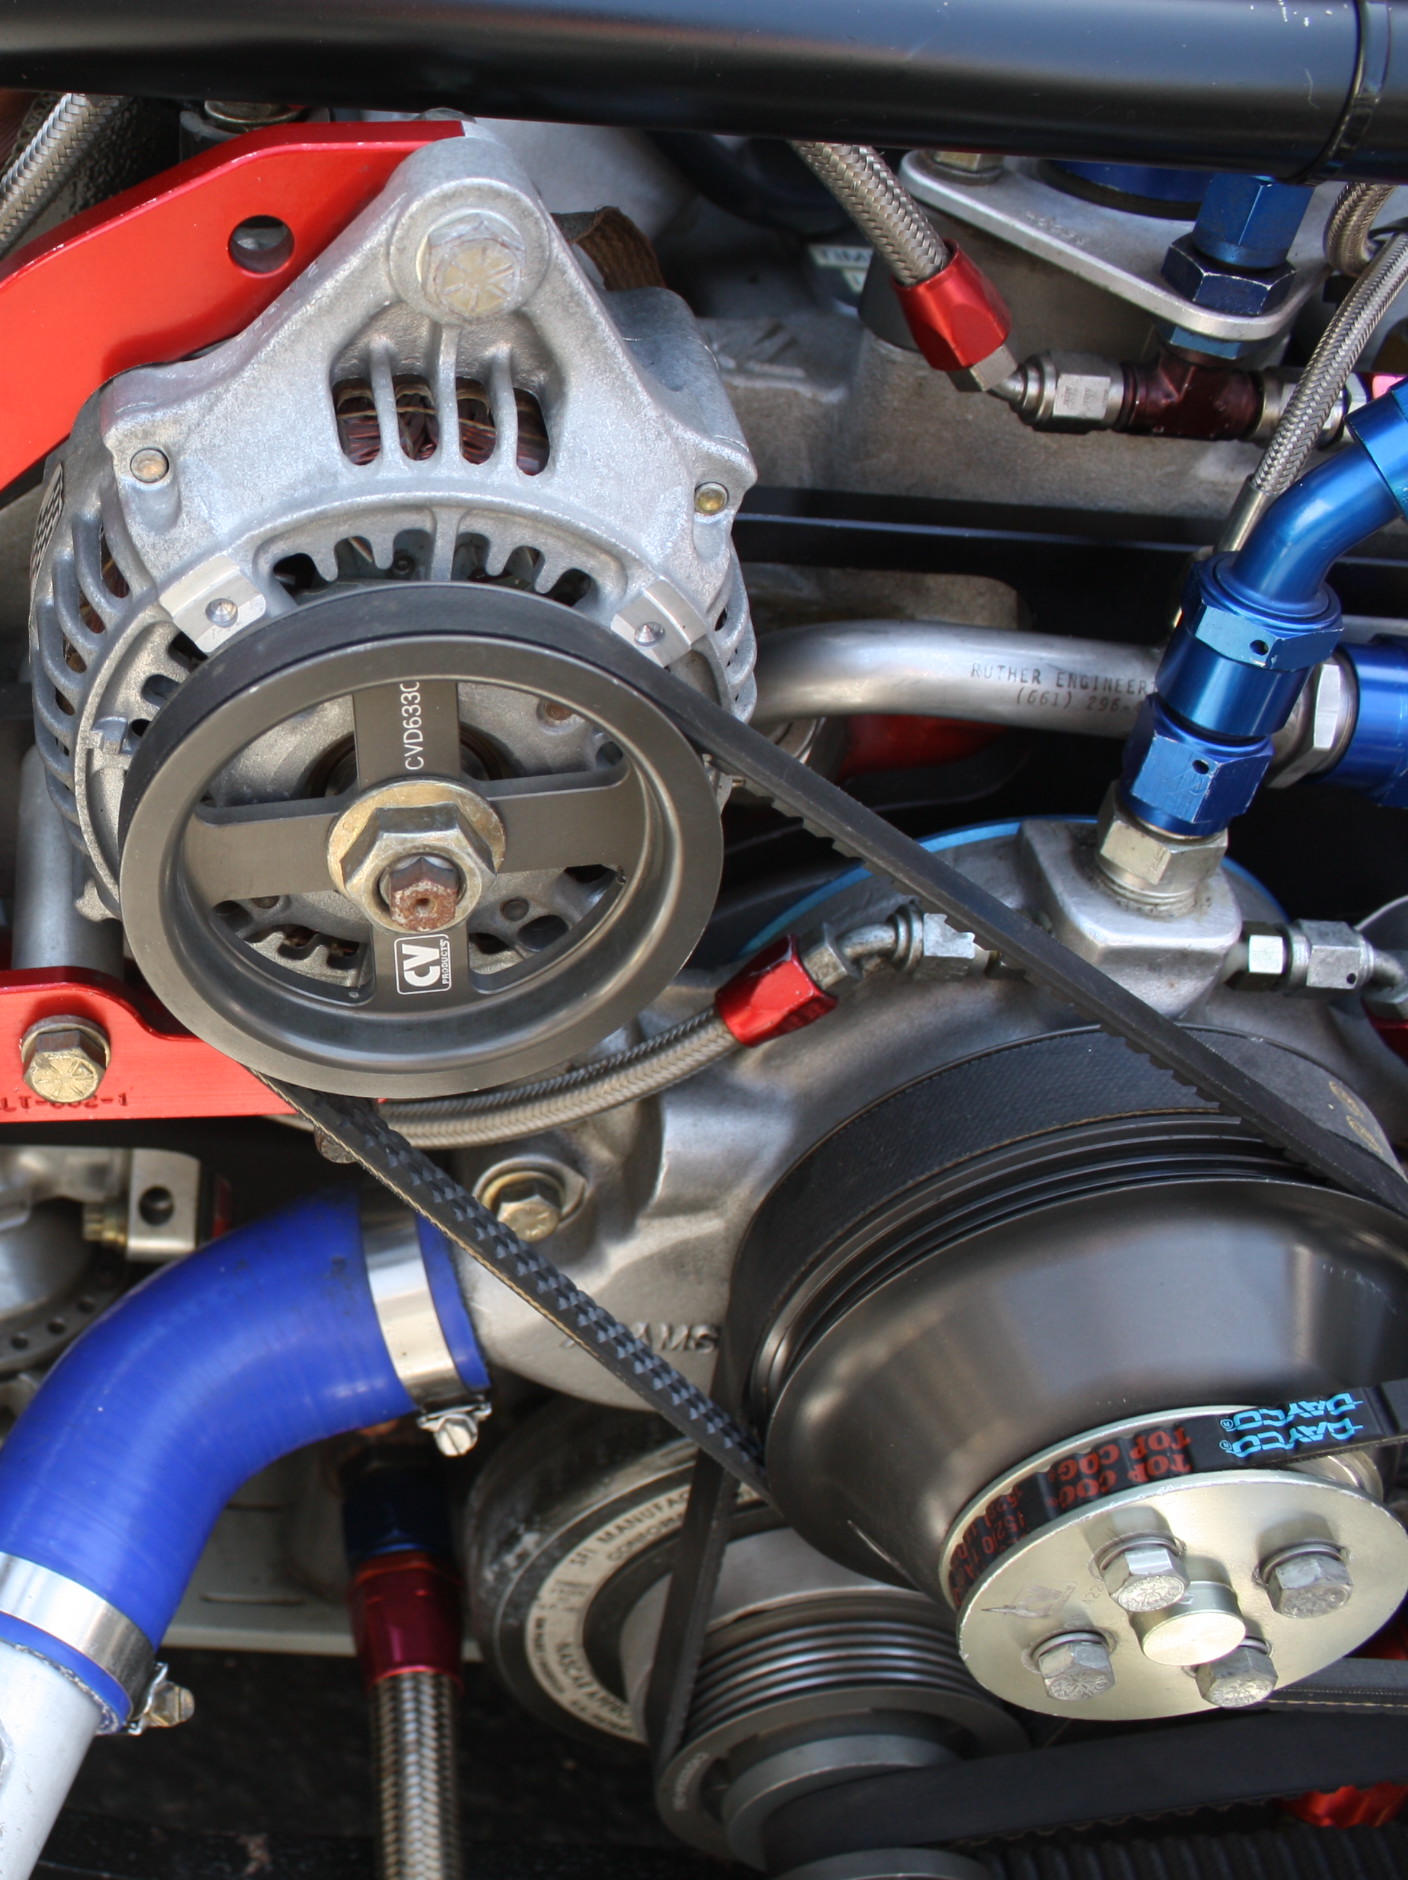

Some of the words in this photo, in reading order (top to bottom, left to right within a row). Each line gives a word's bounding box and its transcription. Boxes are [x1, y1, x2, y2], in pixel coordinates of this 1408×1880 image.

[971, 662, 1041, 684] RUTHER
[402, 943, 440, 987] CV
[1133, 1427, 1192, 1451] TOP
